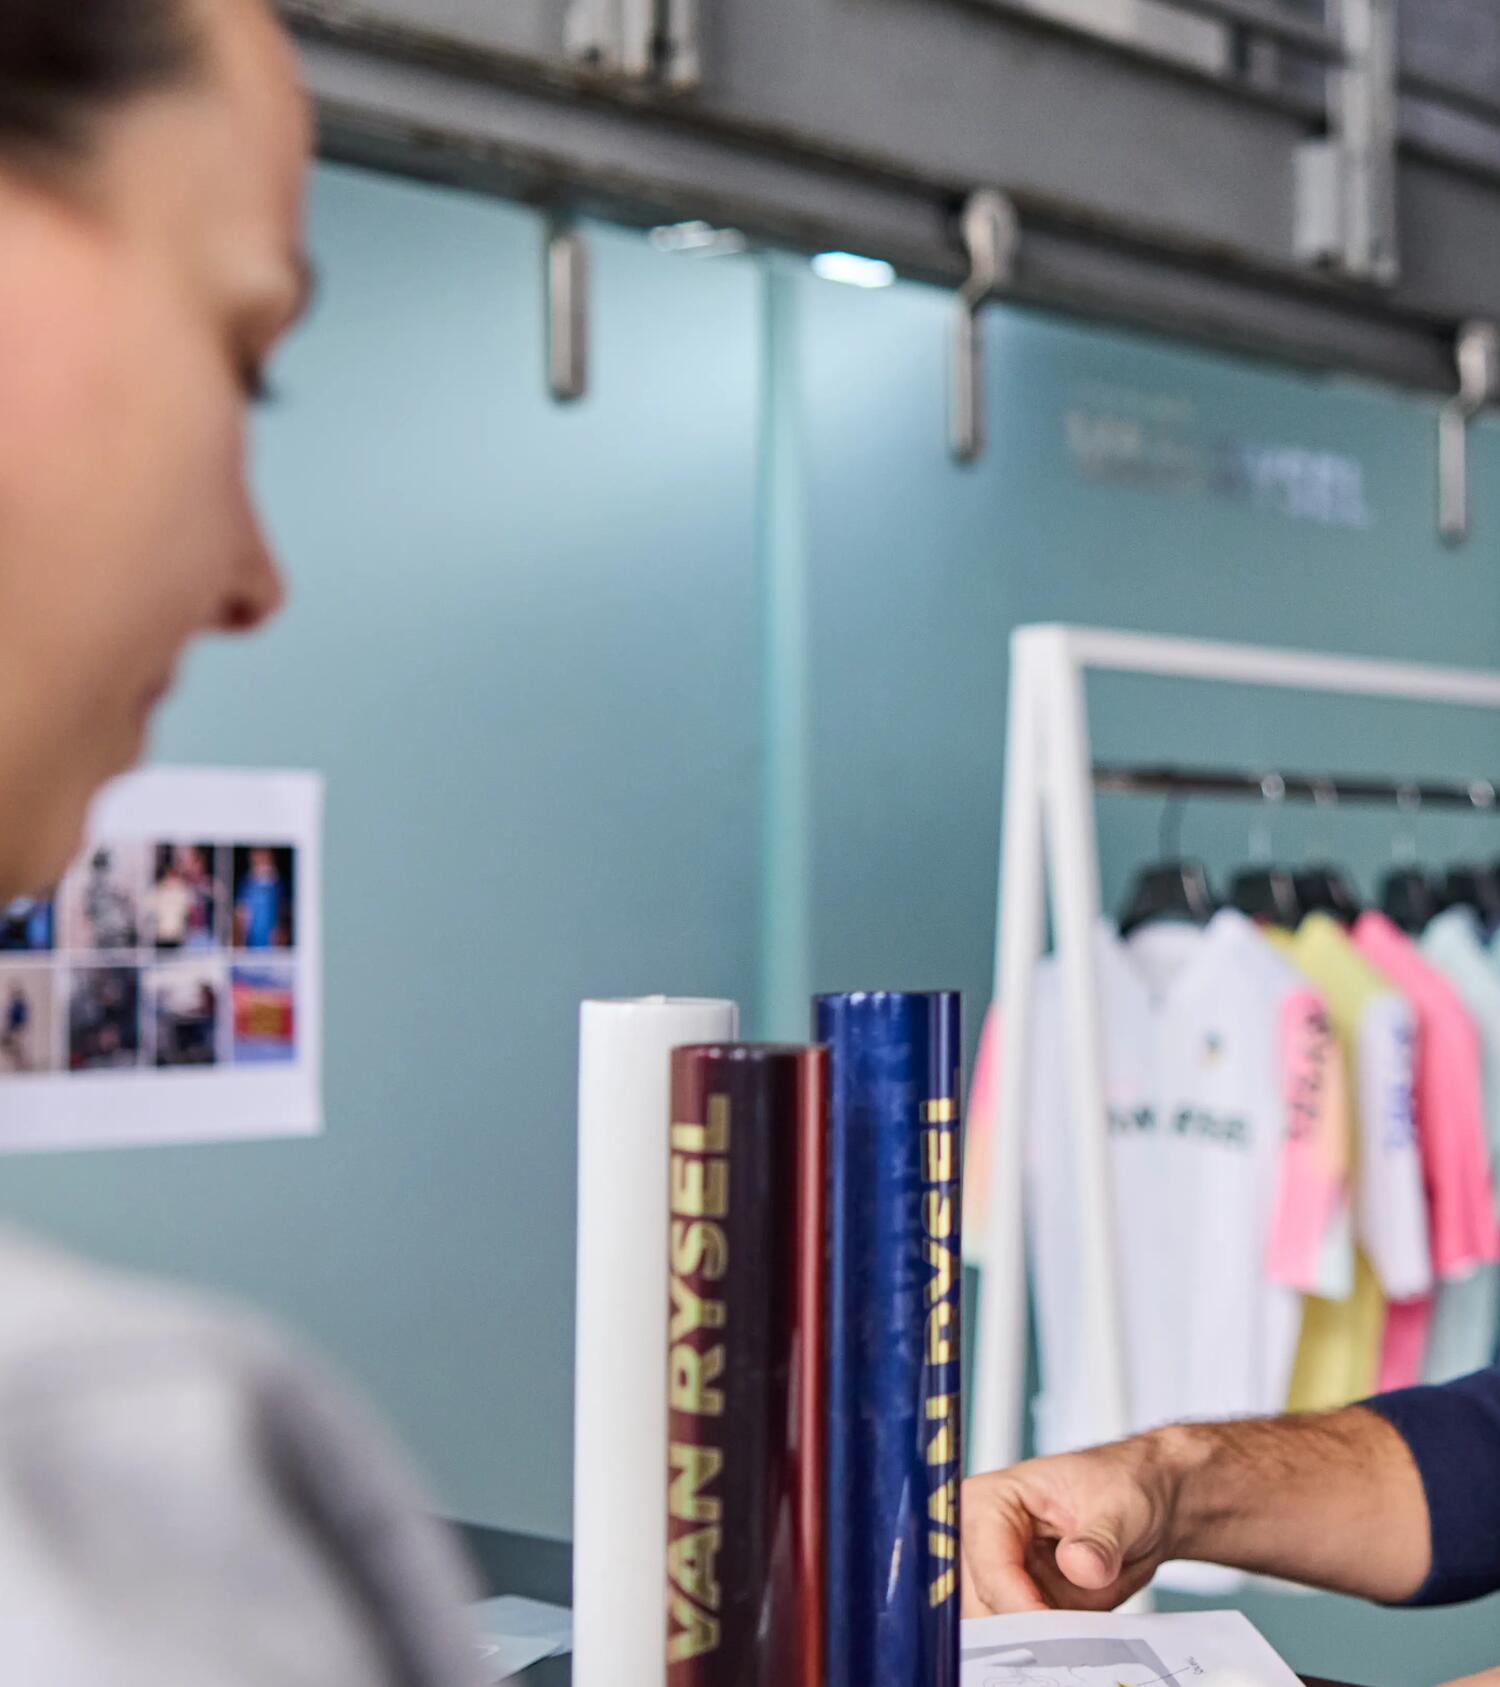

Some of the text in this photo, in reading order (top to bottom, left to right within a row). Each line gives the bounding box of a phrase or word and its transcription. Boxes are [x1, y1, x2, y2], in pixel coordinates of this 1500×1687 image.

[665, 1093, 731, 1664] VAN RYSEL
[925, 1394, 960, 1608] VAN
